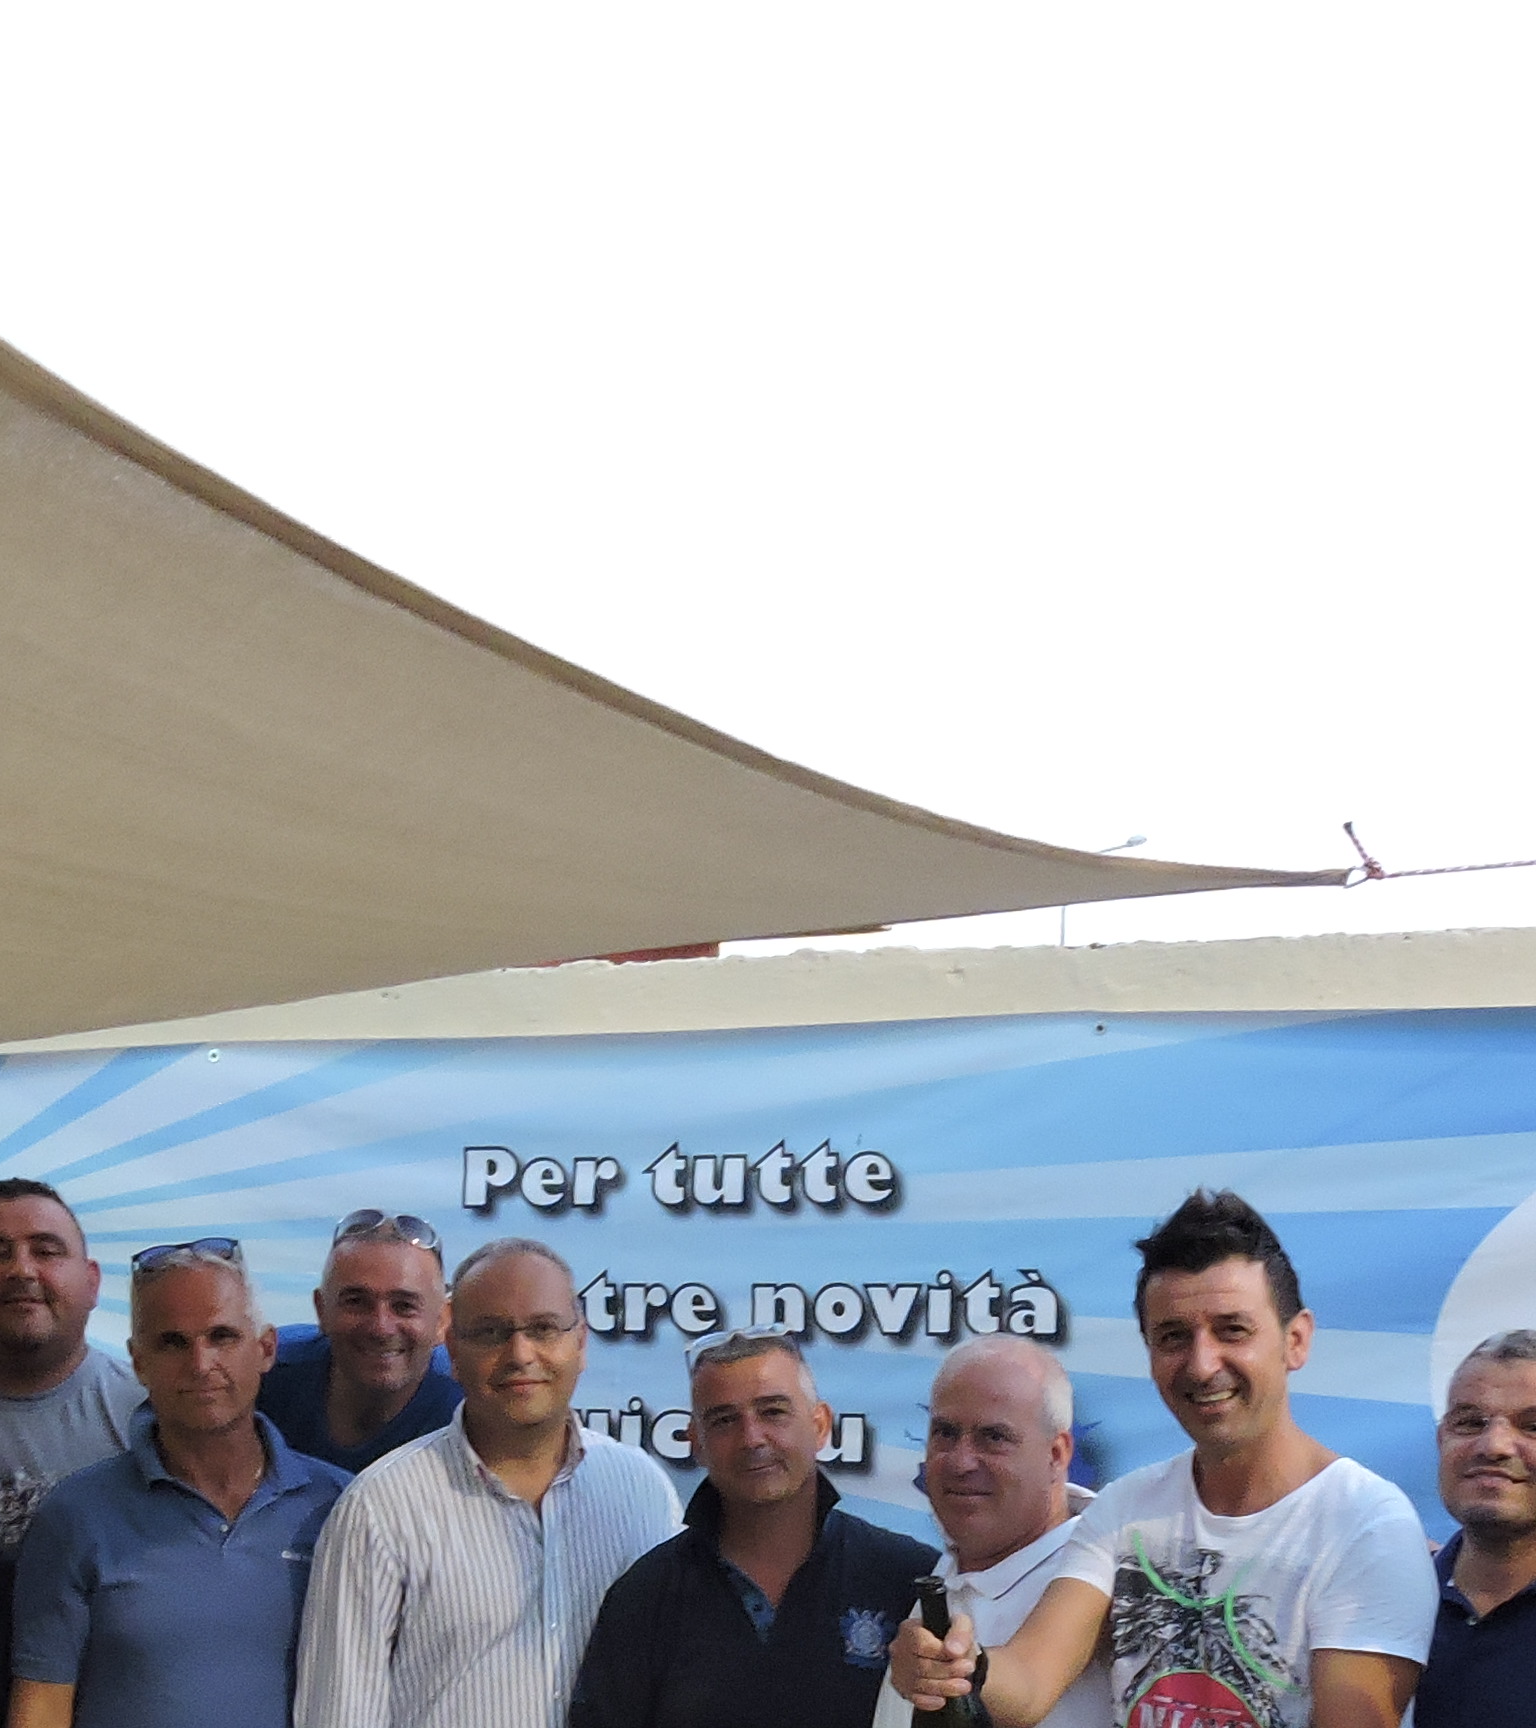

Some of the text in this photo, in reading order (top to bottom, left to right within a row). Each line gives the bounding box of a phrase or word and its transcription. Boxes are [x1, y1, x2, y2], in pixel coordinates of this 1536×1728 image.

[463, 1138, 895, 1209] Per tutte
[578, 1267, 1061, 1337] tre novità
